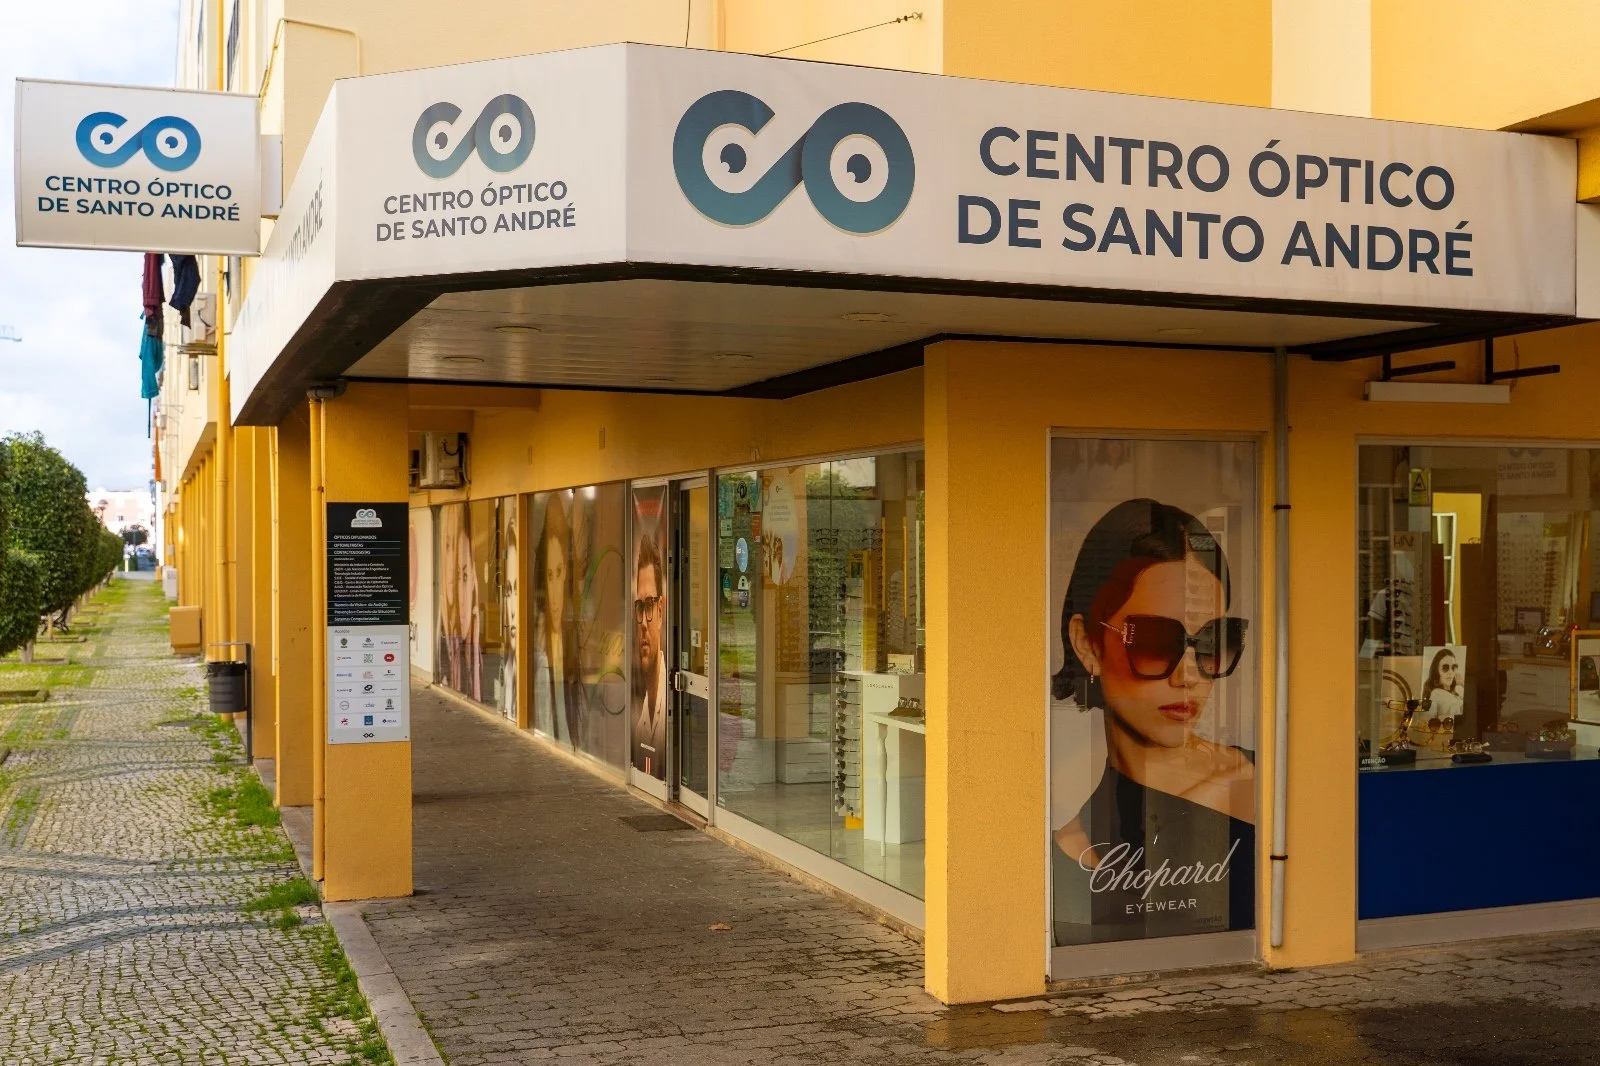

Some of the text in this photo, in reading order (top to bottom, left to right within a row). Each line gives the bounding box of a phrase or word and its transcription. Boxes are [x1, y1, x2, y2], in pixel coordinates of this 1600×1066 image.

[978, 126, 1455, 210] CENTRO ÓPTICO
[45, 176, 232, 199] CENTRO ÓPTICO
[384, 180, 568, 215] CENTRO ÓPTICO
[38, 196, 240, 221] DE SANTO ANDRÉ
[376, 203, 576, 242] DE SANTO ANDRÉ
[958, 194, 1474, 277] DE SANTO ANDRÉ
[1362, 757, 1386, 765] ATENÇÃO
[1078, 838, 1240, 899] Chopard
[1126, 898, 1197, 914] EYEWEAR
